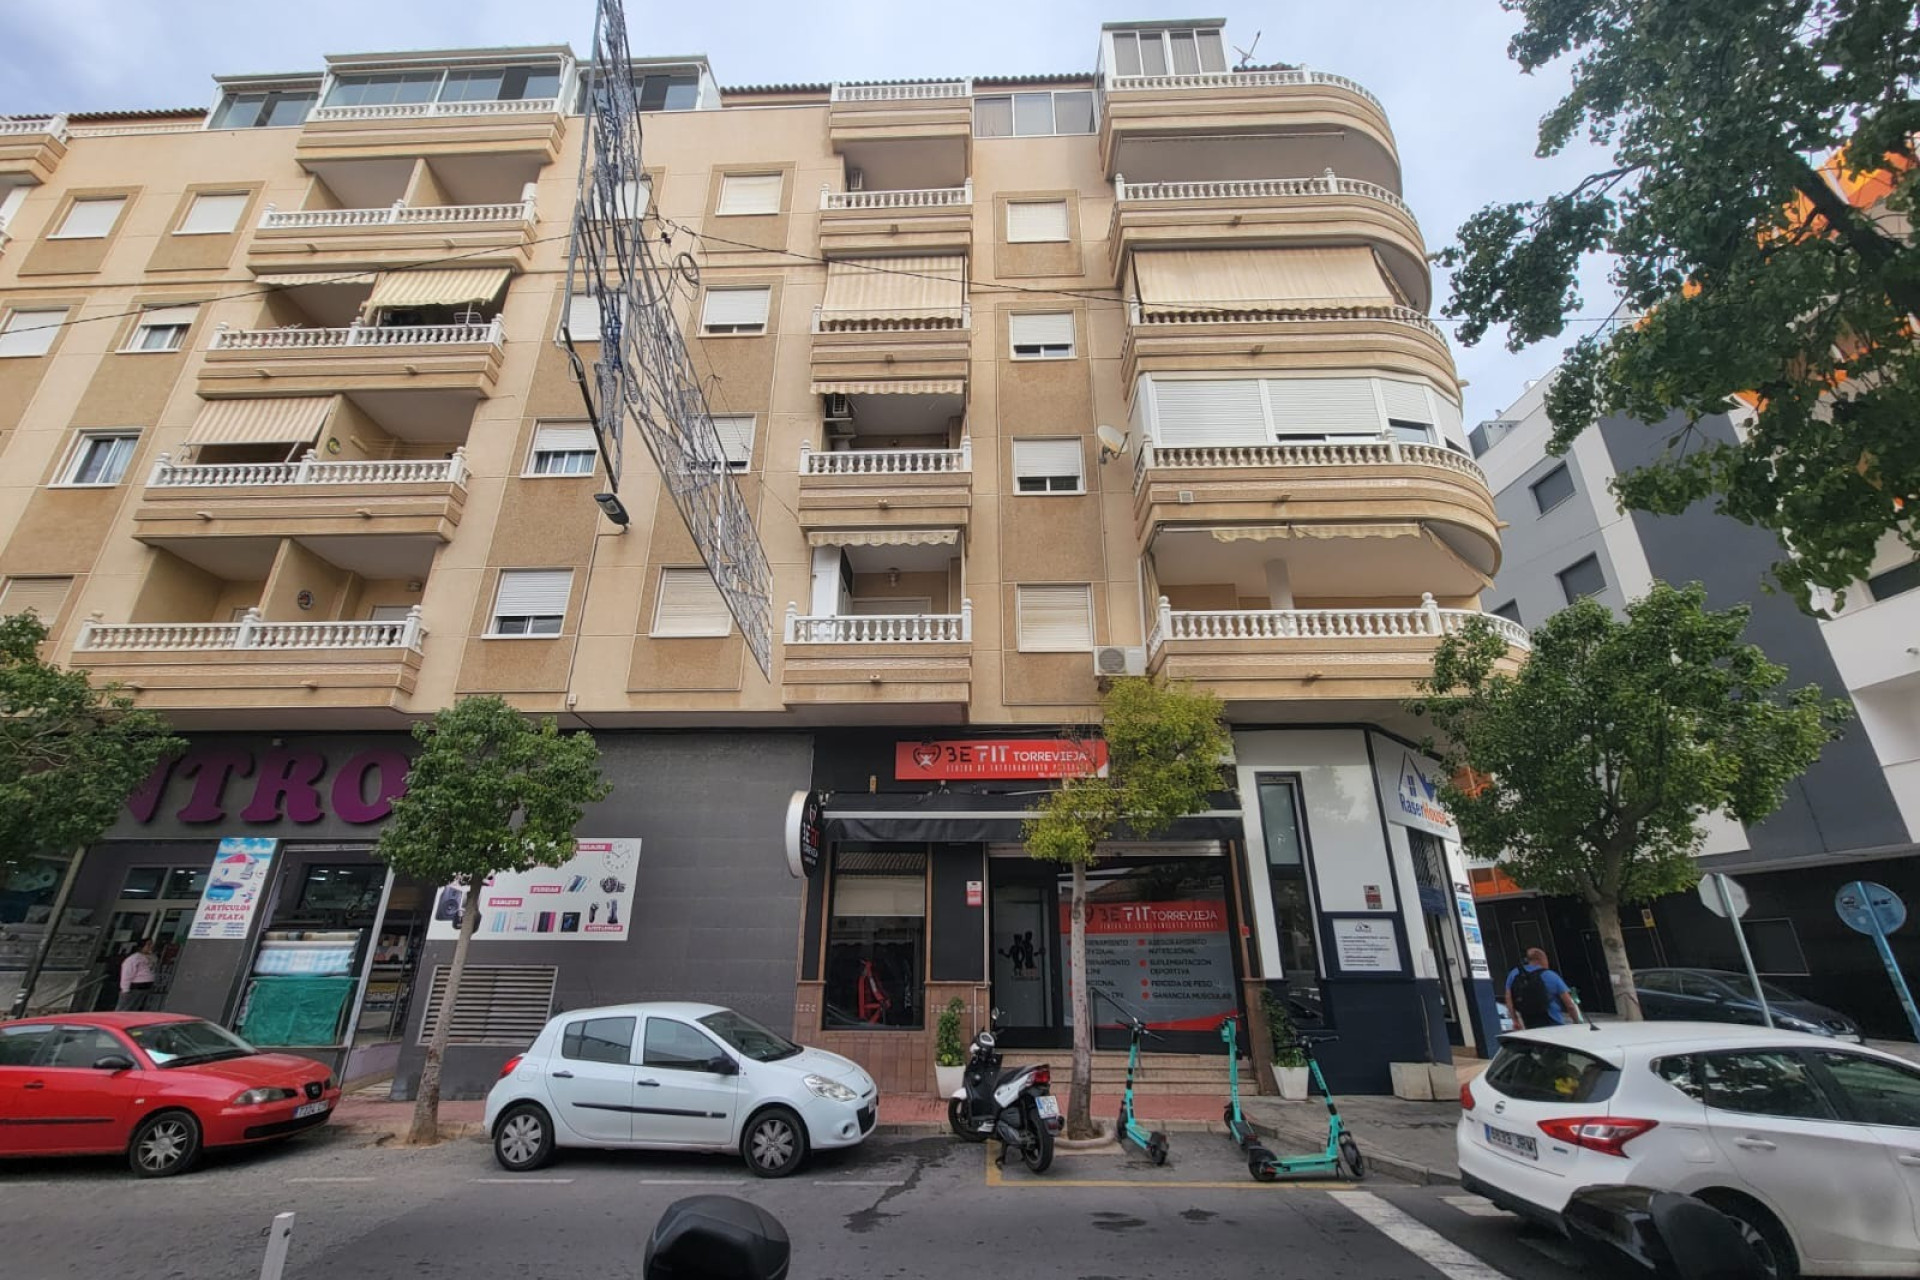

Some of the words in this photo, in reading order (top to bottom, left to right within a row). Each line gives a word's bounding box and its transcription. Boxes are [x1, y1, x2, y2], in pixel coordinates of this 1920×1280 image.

[974, 745, 1010, 763] FIT
[1013, 750, 1087, 762] TORREVIEJA
[1120, 906, 1151, 922] FIT
[1151, 910, 1218, 922] TORREVIEJA
